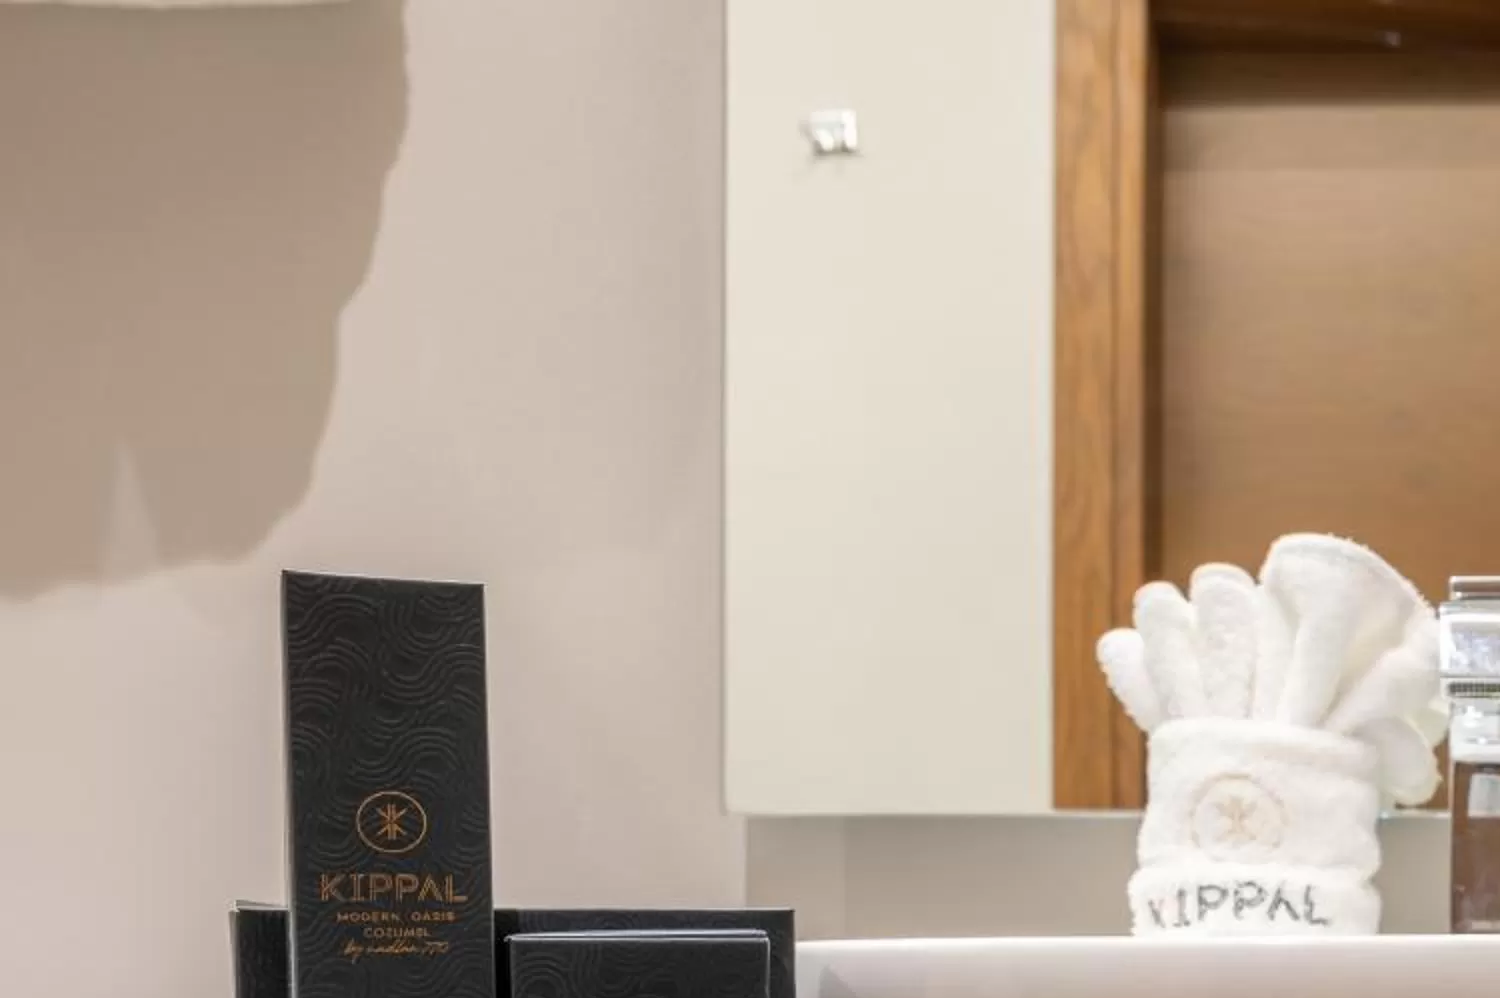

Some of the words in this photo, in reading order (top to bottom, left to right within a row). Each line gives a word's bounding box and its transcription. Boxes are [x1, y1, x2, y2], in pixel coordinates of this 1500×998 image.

[319, 873, 469, 903] KIPPAL
[336, 911, 400, 922] MODERN
[411, 911, 456, 922] OASIS
